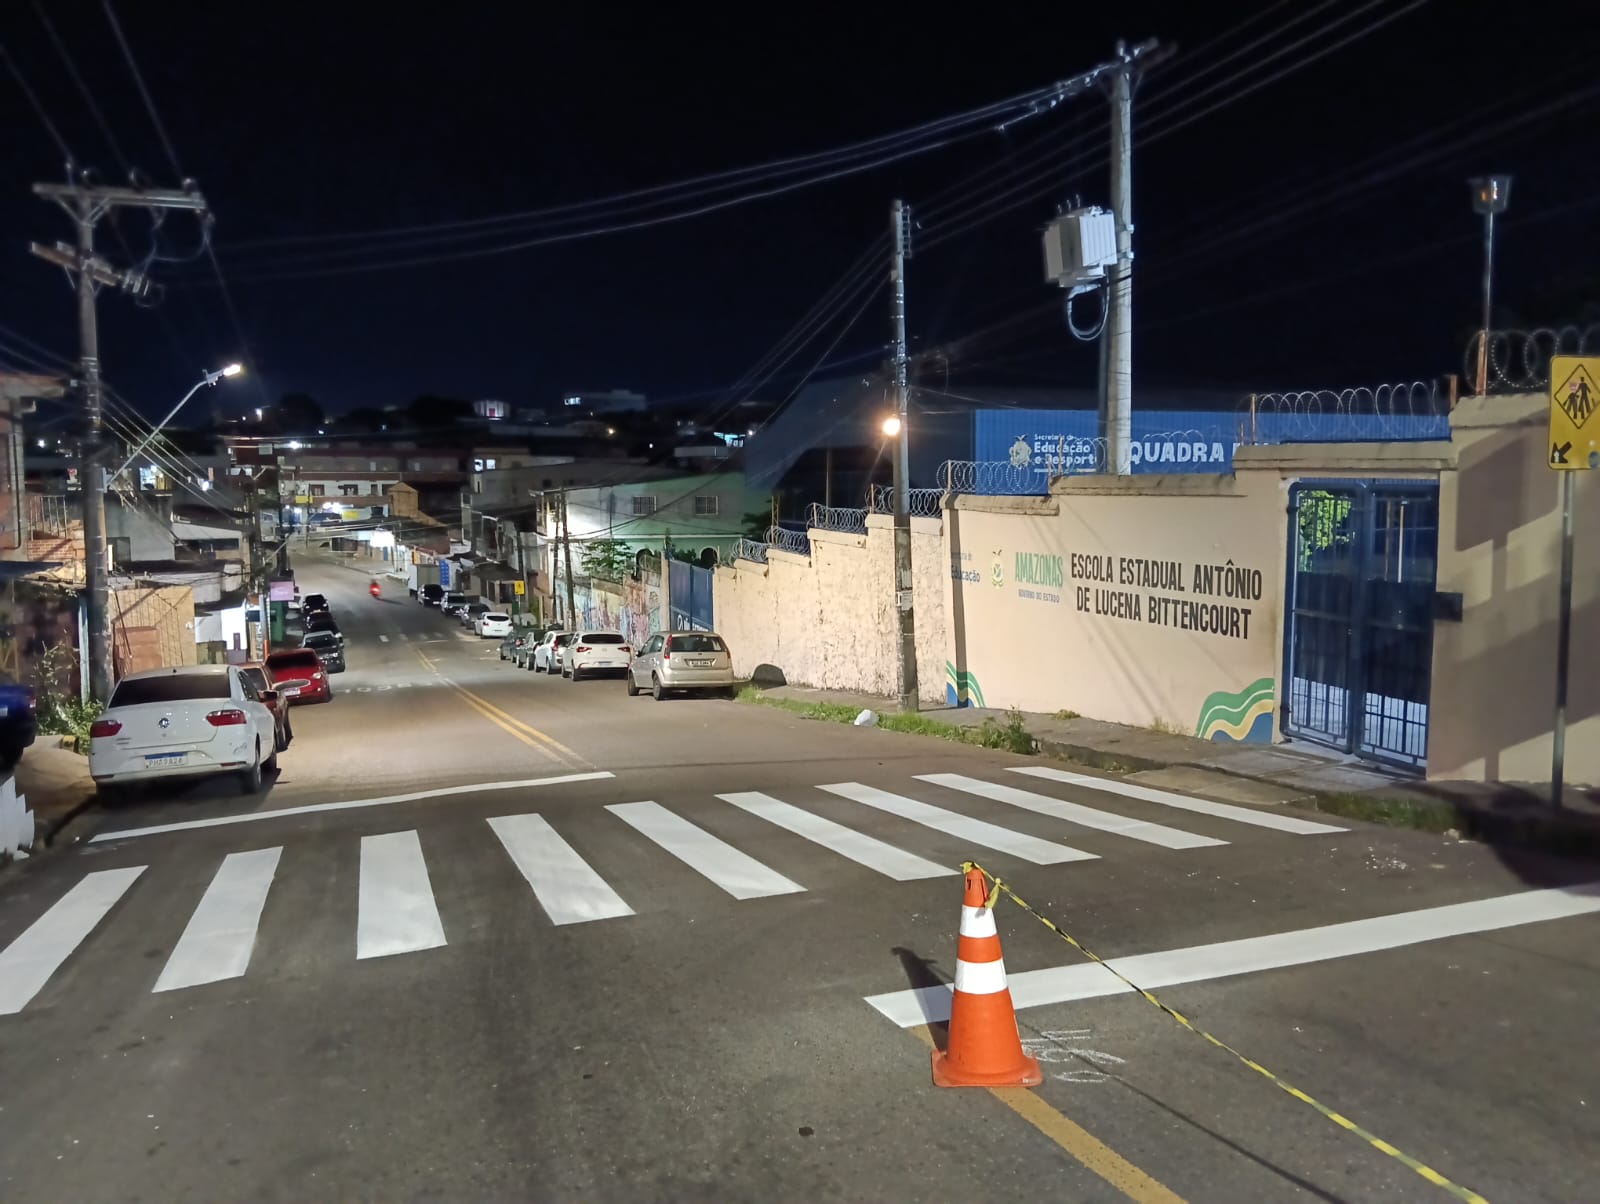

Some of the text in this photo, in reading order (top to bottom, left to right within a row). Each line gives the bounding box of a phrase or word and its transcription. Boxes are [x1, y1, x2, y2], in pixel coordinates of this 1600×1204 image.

[1034, 441, 1091, 456] Educação
[1034, 454, 1097, 467] e Desport
[1130, 441, 1225, 465] QUADRA
[1015, 551, 1063, 588] AMAZONAS
[1071, 552, 1262, 601] ESCOLA ESTADUAL ANTÔNIO
[1077, 586, 1251, 640] DE LUCENA BITTENCOURT
